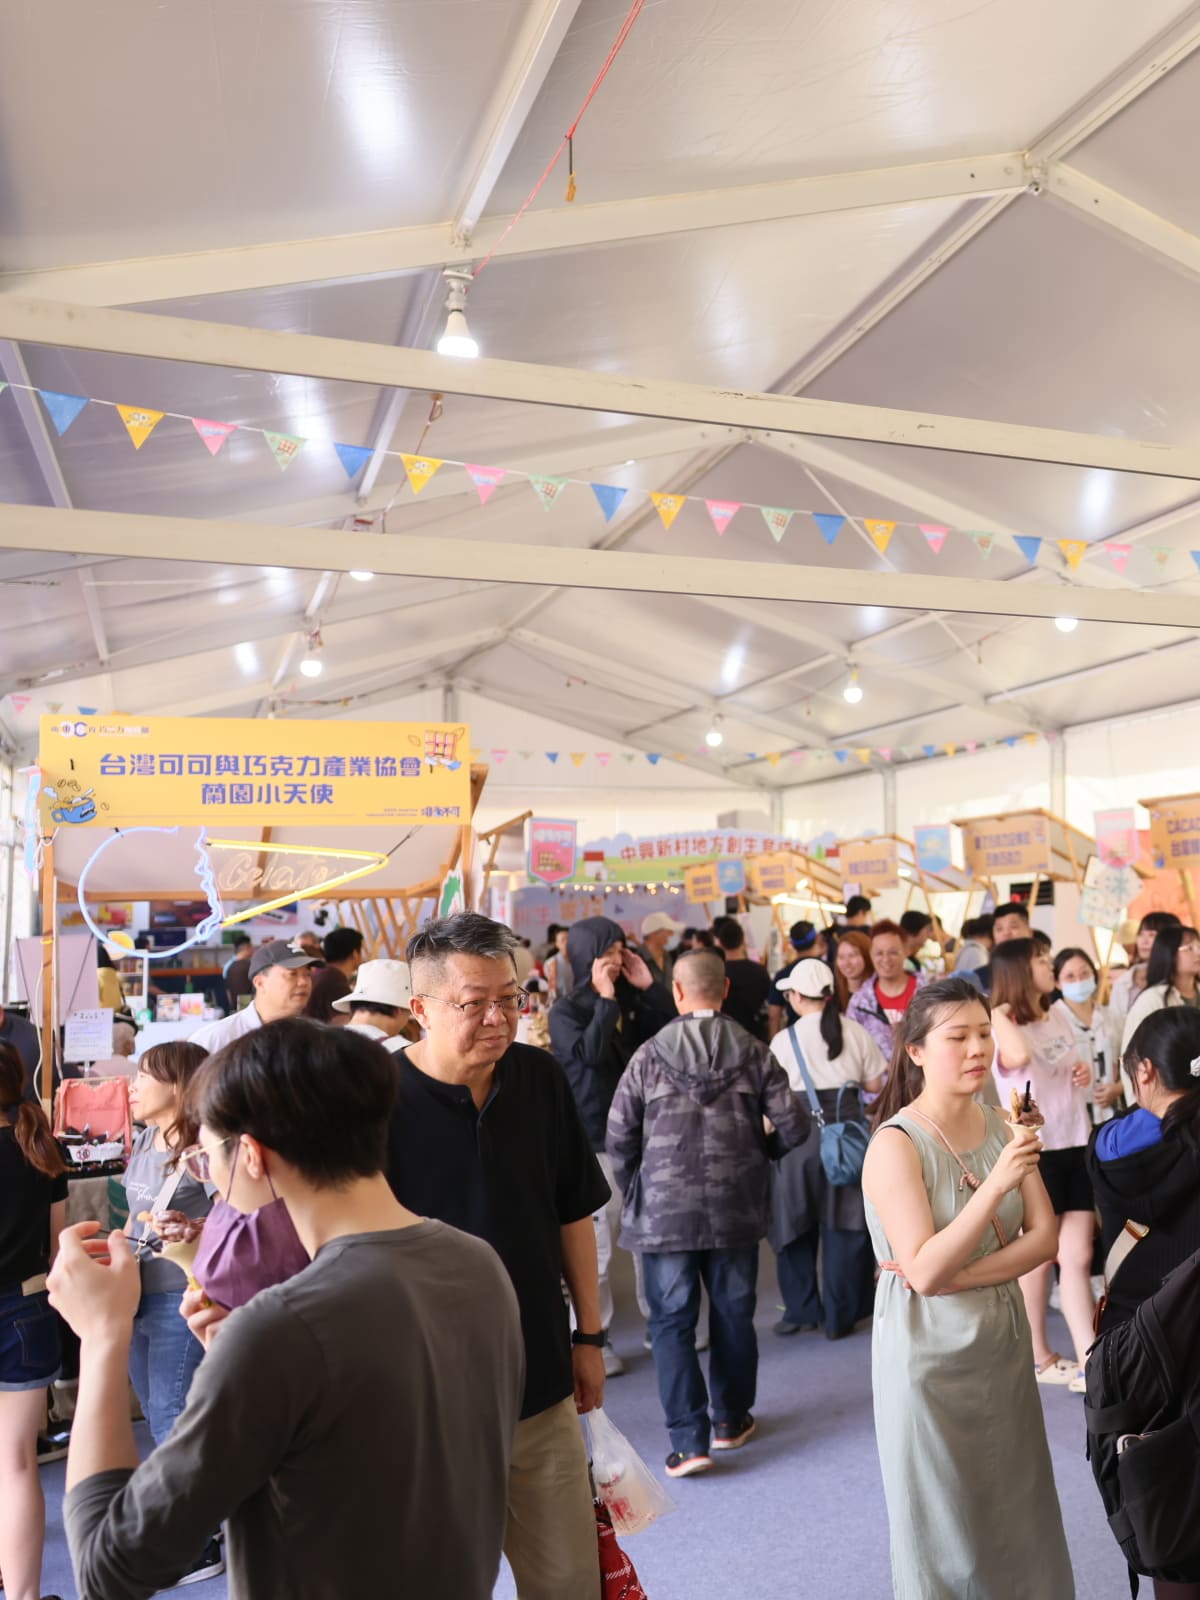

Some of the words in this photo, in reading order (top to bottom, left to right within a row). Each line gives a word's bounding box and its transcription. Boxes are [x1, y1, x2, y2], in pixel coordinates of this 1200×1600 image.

[100, 753, 421, 777] 台灣可可與巧克力產業協會
[201, 783, 333, 805] 蘭園小天使
